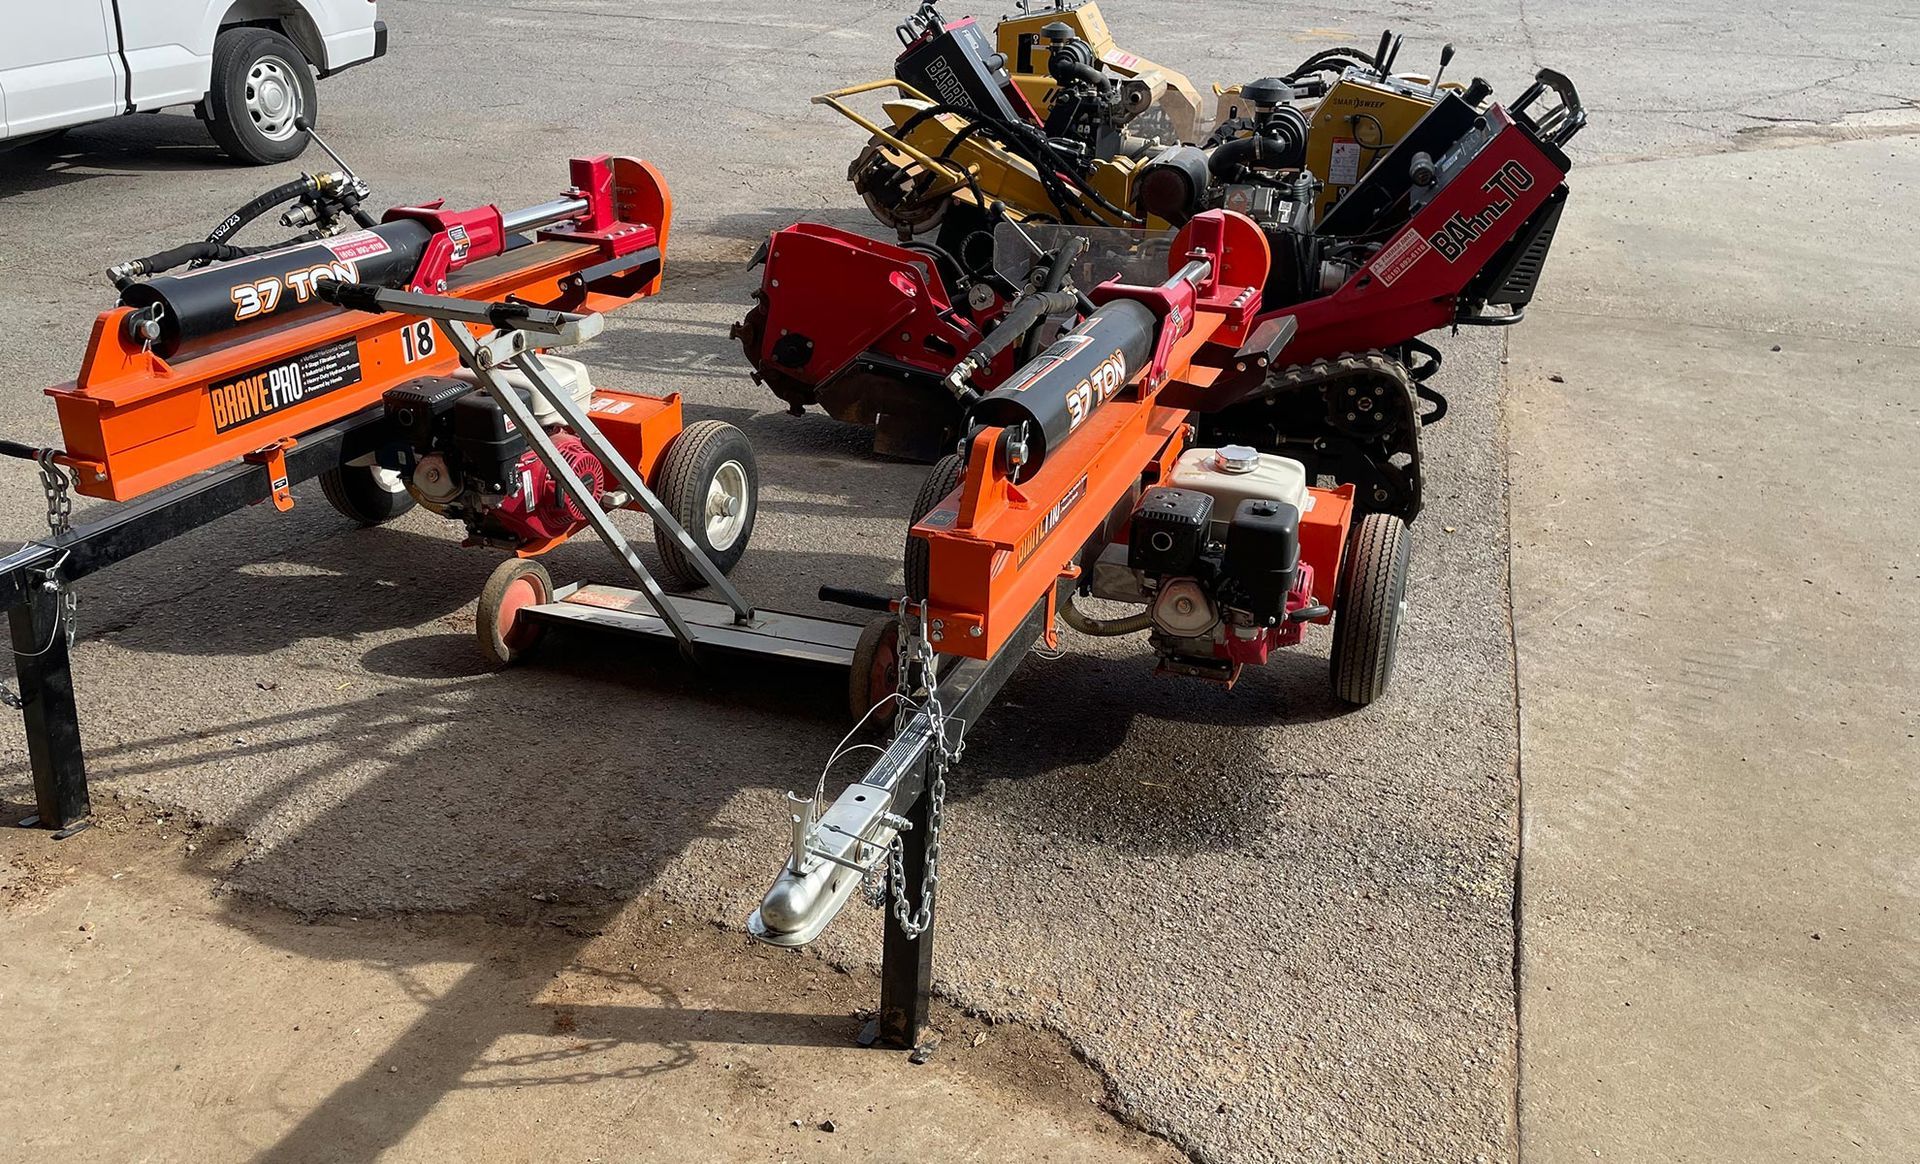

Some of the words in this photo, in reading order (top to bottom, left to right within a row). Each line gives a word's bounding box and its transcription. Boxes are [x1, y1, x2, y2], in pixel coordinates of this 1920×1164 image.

[925, 55, 977, 109] BARRE
[231, 277, 282, 321] 37
[402, 321, 433, 361] 18
[211, 362, 303, 429] BRAVEPRO
[1066, 379, 1092, 434] 37
[1090, 349, 1126, 406] TON
